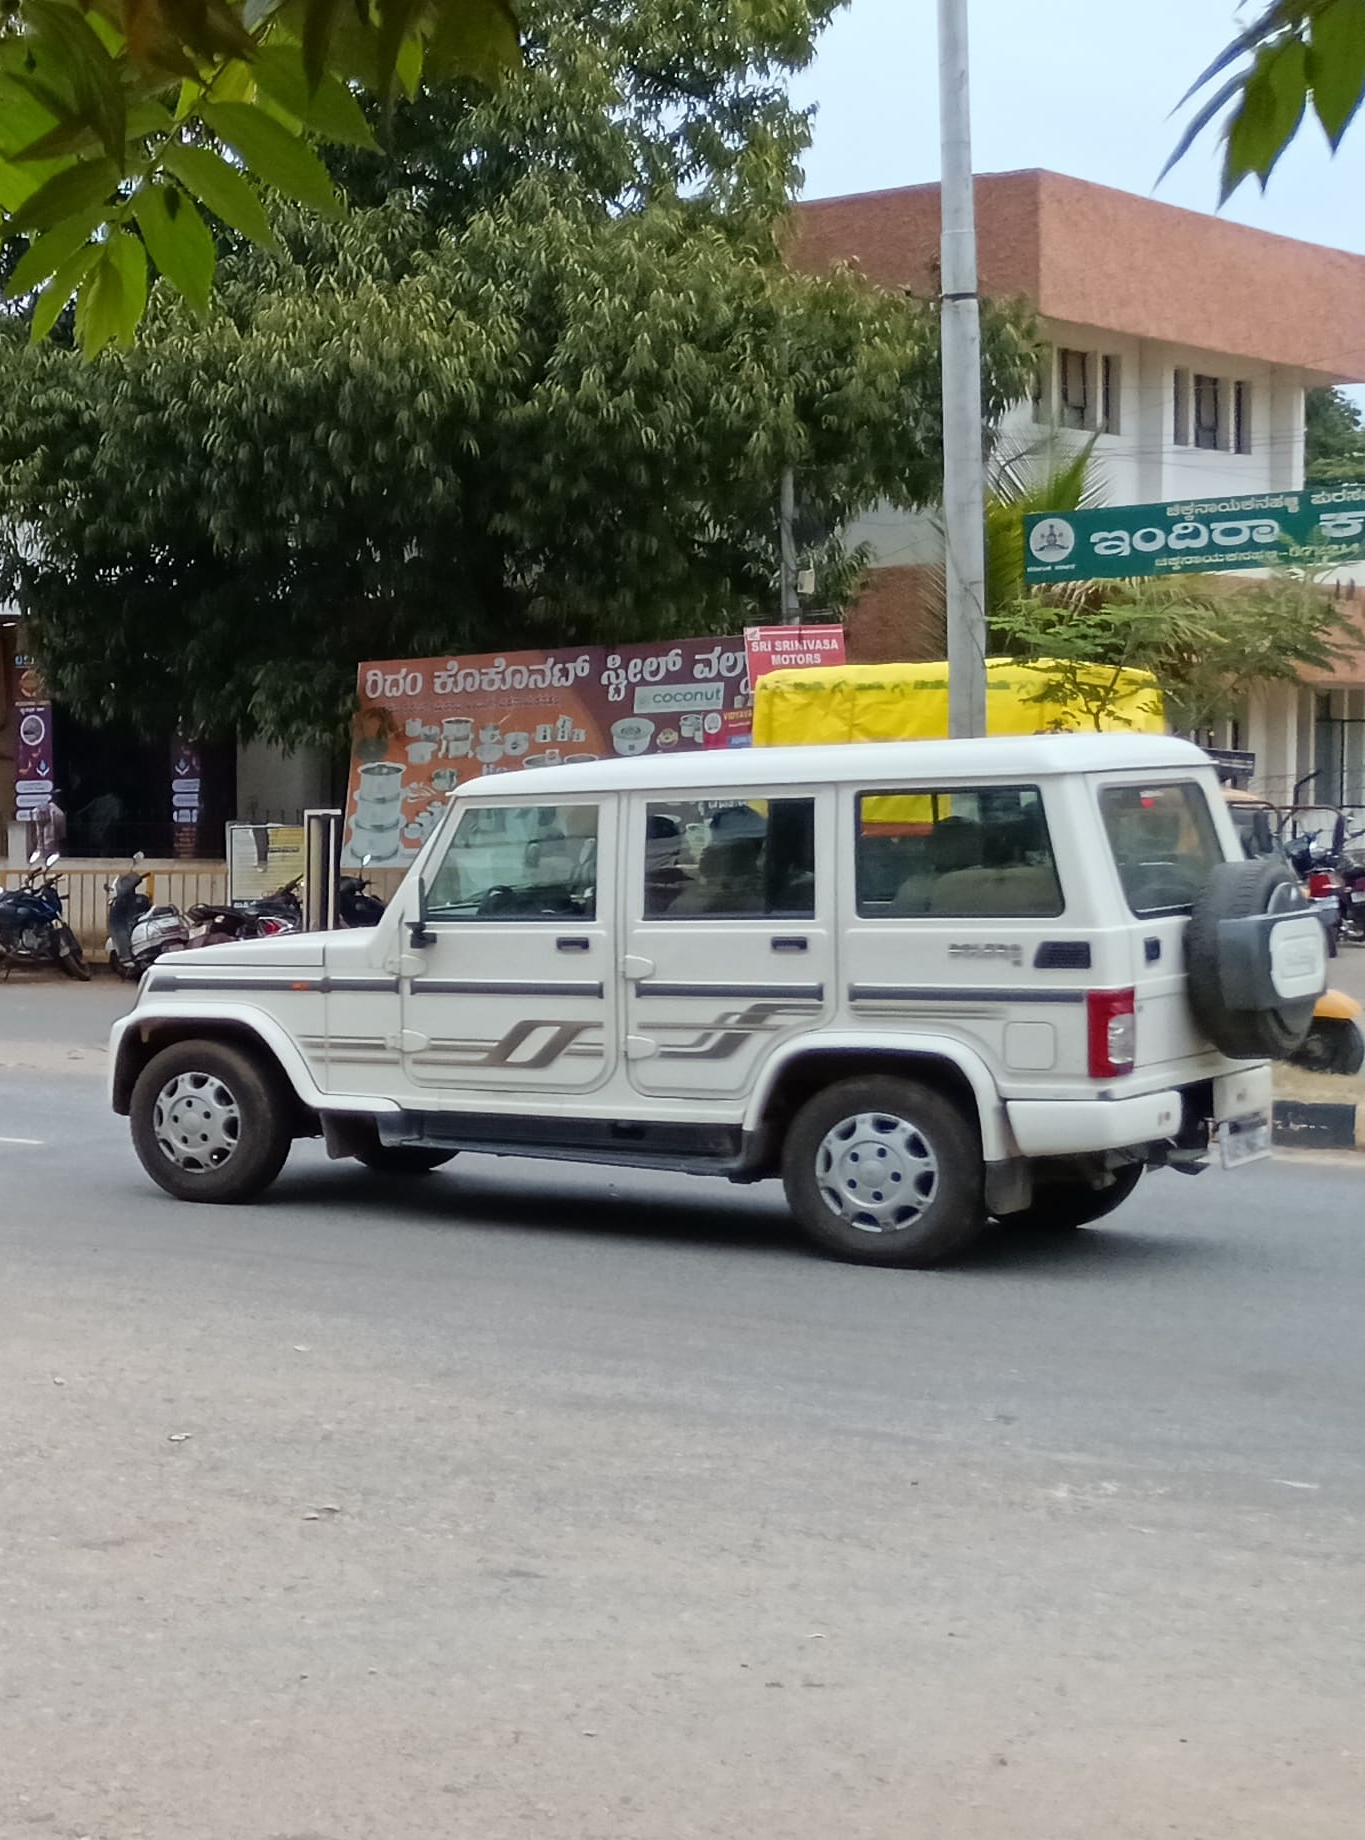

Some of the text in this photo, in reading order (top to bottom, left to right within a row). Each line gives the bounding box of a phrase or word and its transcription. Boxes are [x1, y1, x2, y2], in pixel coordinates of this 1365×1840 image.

[1089, 519, 1280, 556] ಇಂದಿರಾ
[751, 639, 839, 652] SRI SRINIVASA
[771, 653, 822, 666] MOTORS
[652, 688, 721, 704] coconut
